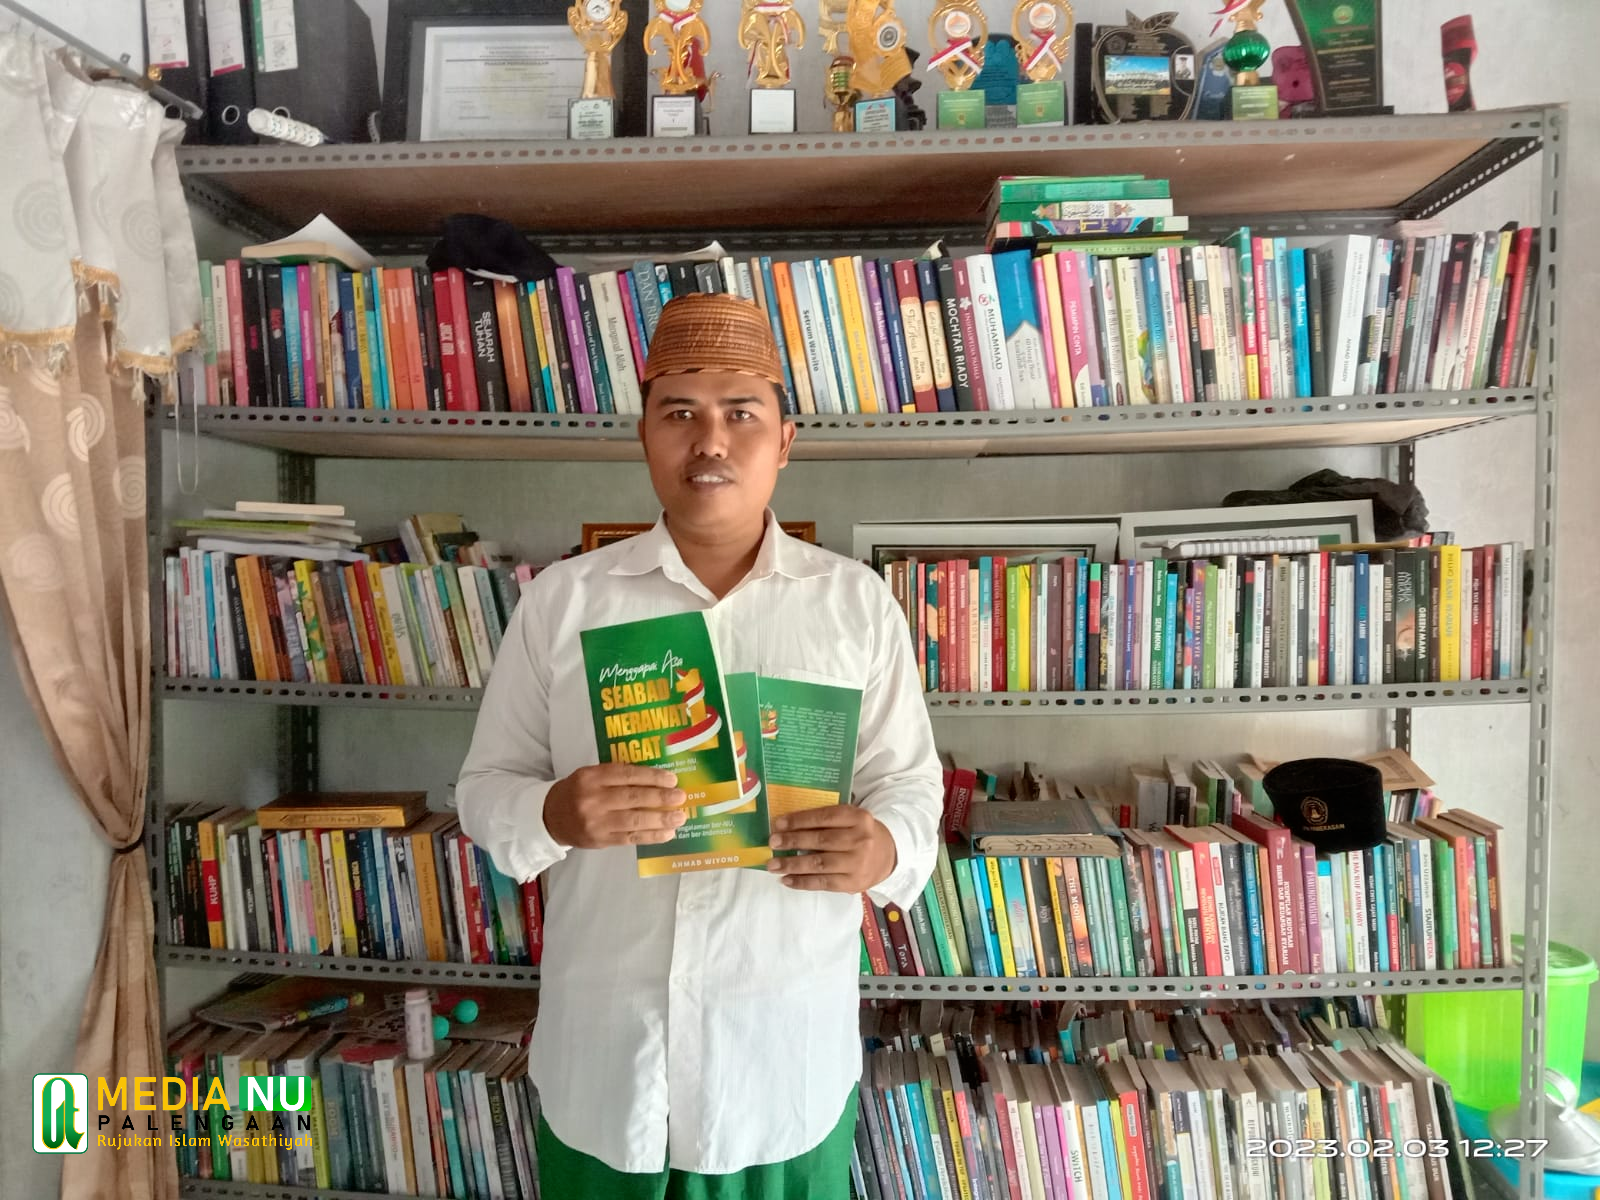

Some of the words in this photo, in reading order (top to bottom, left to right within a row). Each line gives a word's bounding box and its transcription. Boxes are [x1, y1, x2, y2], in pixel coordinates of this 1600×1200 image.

[474, 319, 486, 358] TUHAN
[482, 311, 495, 362] SEJARAH
[945, 298, 962, 353] MOCHTAR
[954, 355, 968, 388] RIADY
[986, 308, 1003, 370] MUHAMMAD
[1418, 633, 1426, 659] MAMA
[601, 678, 670, 711] SEABAD
[605, 703, 689, 738] MERAWAT
[672, 859, 701, 869] AHMAD
[704, 856, 739, 865] WIYONO
